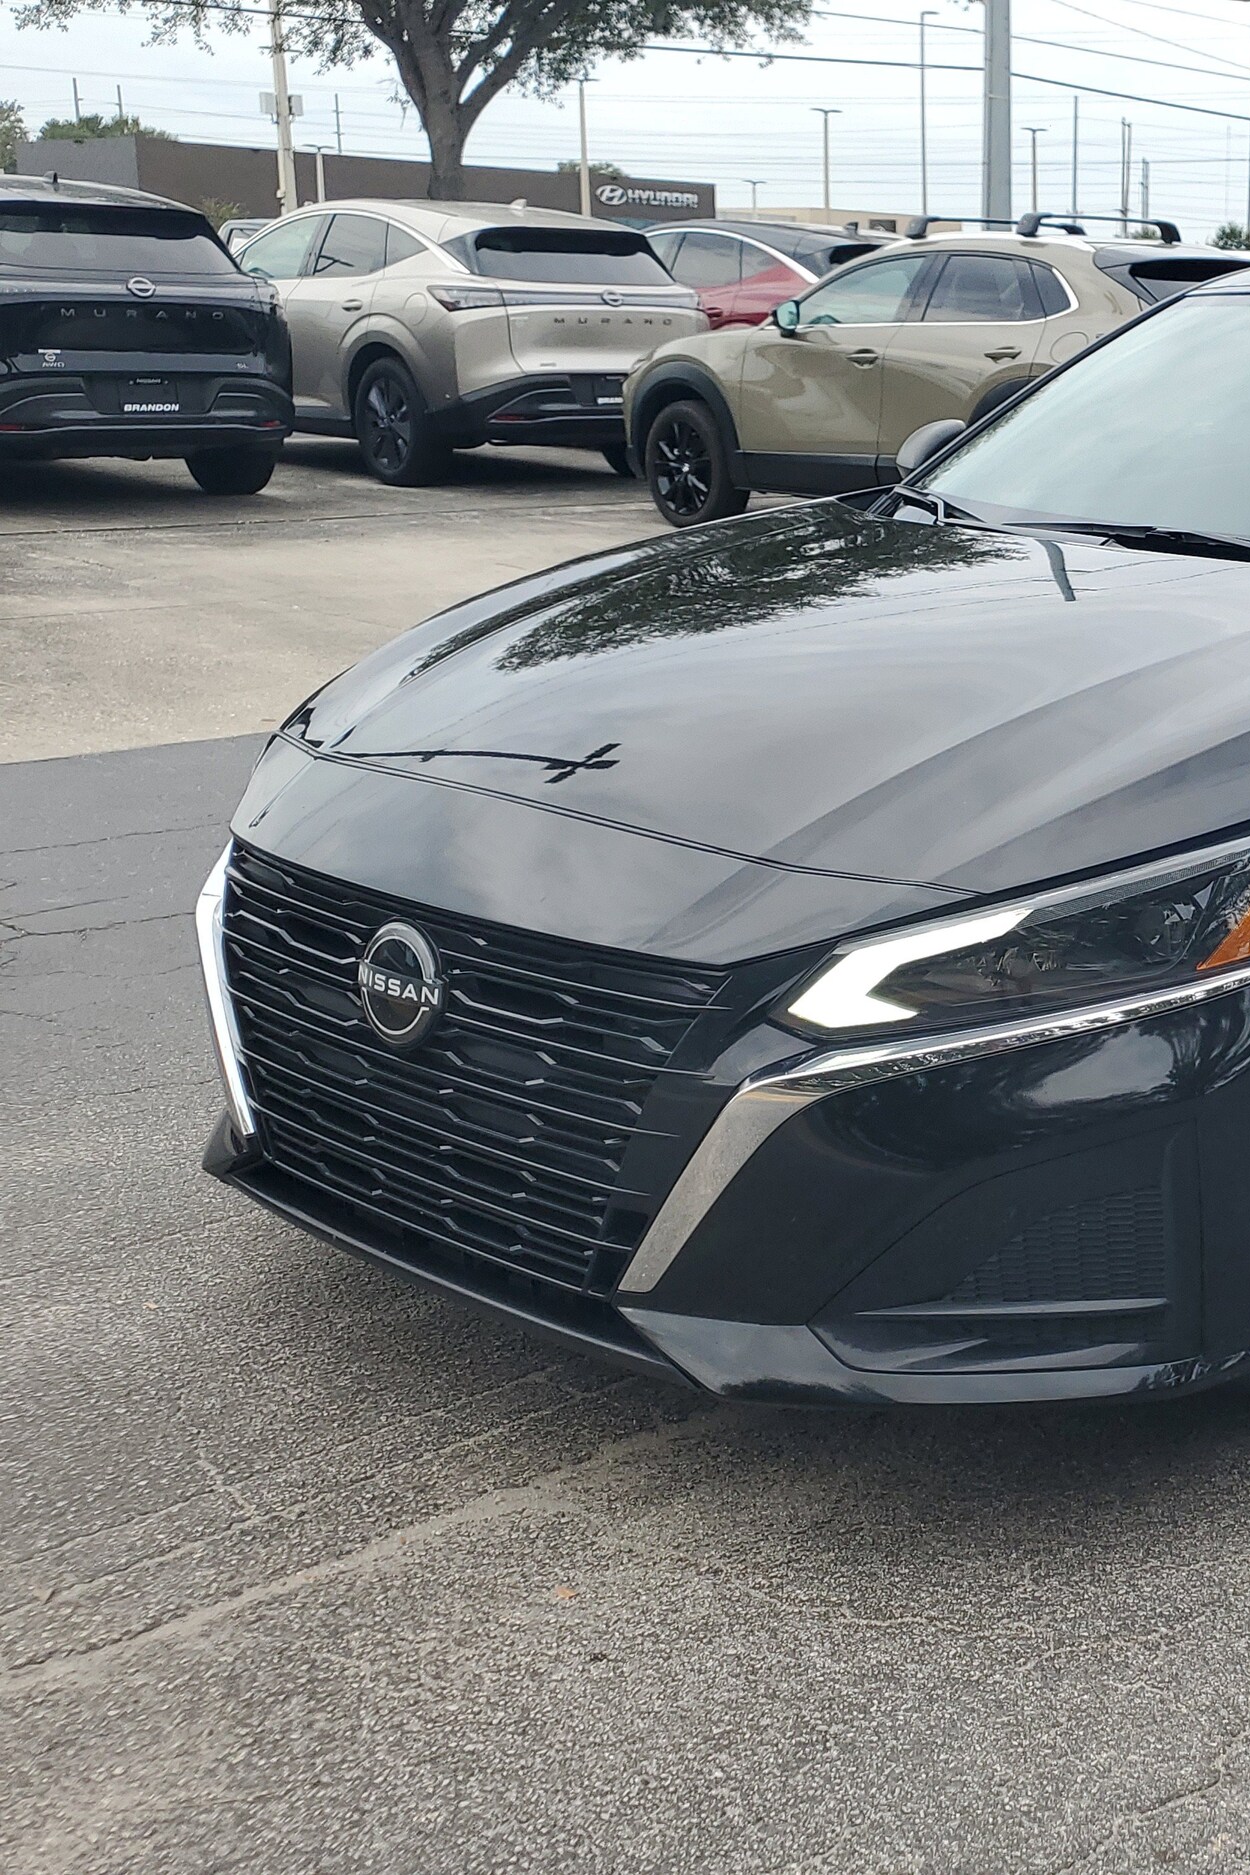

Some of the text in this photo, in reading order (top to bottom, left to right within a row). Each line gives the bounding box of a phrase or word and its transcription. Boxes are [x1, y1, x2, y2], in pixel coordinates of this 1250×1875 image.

[627, 188, 698, 209] HYUNDAI
[60, 308, 224, 320] MURANO
[553, 317, 673, 326] MURANO
[123, 403, 179, 412] BRANDON
[359, 965, 439, 1005] NISSAN
